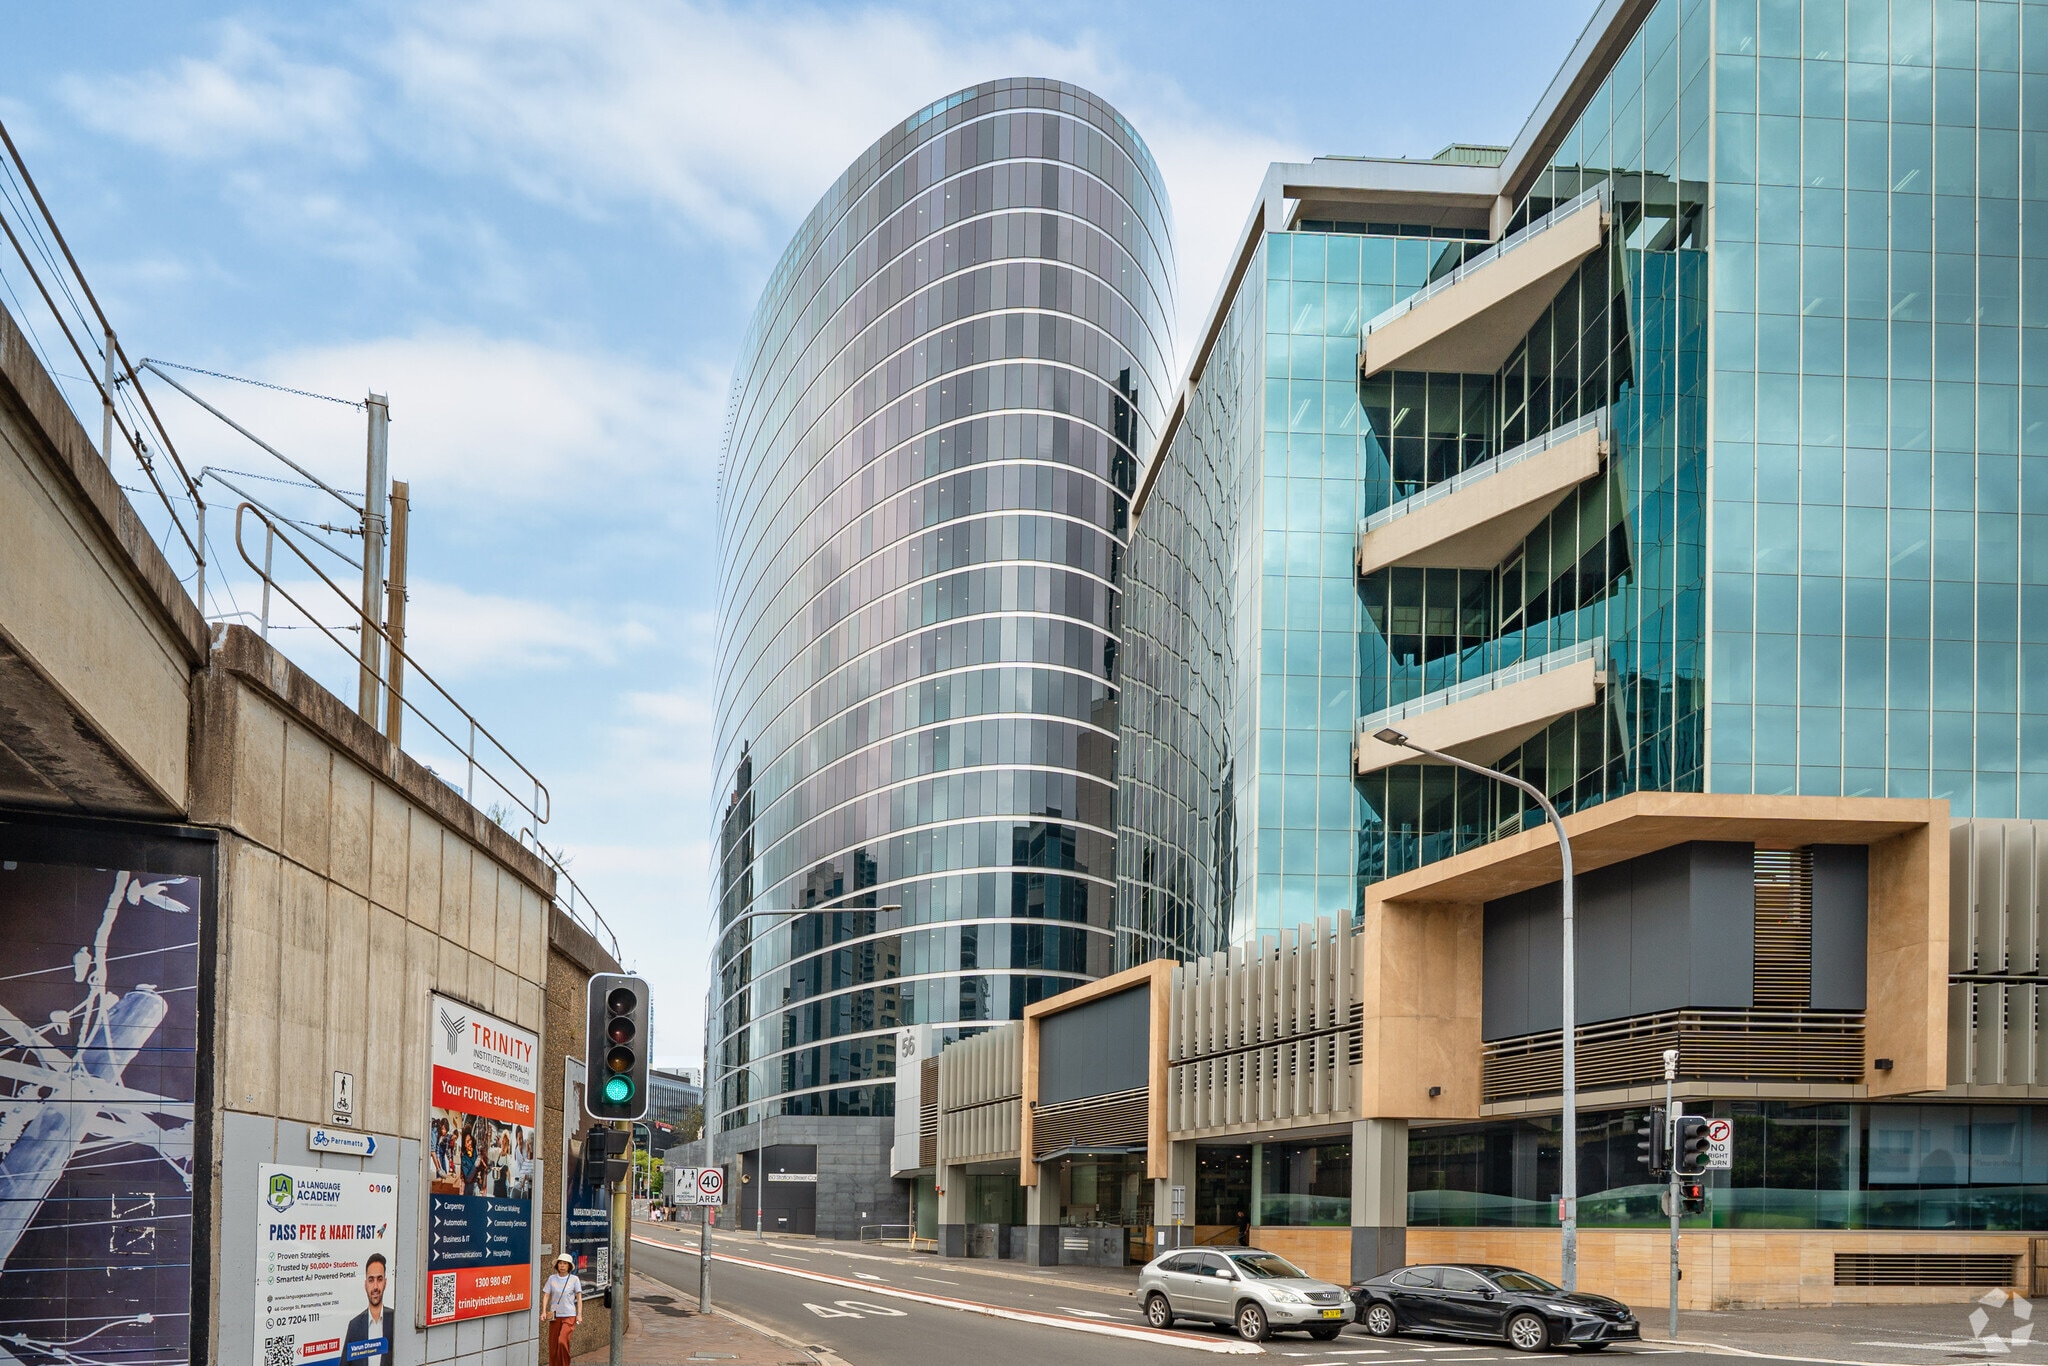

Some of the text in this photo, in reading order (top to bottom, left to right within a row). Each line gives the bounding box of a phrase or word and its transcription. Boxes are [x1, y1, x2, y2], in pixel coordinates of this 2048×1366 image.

[472, 1022, 532, 1063] TRINITY
[902, 1035, 915, 1058] 56
[441, 1080, 530, 1114] Your FUTURE starts here
[331, 1137, 363, 1147] Parramatta
[1711, 1144, 1725, 1152] NO
[275, 1179, 288, 1192] LA
[297, 1180, 341, 1191] LA LANGUAGE
[702, 1176, 720, 1188] 40
[297, 1190, 341, 1202] ACADEMY
[699, 1195, 722, 1203] AREA
[444, 1202, 465, 1212] Carpentry
[443, 1219, 468, 1227] Automotive
[494, 1220, 514, 1228] Community
[269, 1224, 376, 1241] PASS PTE & NAATI FAST
[493, 1235, 508, 1243] Cookery
[1103, 1238, 1117, 1254] 56
[277, 1251, 331, 1260] Proven Strategies.
[442, 1251, 482, 1259] Telecommunications
[277, 1261, 358, 1272] Trusted by 50,000+ Students.
[276, 1275, 304, 1284] Smartest
[314, 1272, 339, 1280] Powered
[339, 1271, 356, 1279] Portal.
[475, 1275, 512, 1288] 1300 980 497
[458, 1292, 524, 1310] trinityinstitute.edu.au
[802, 1300, 908, 1319] 40
[276, 1313, 320, 1327] 02 7204 1111
[305, 1341, 338, 1353] FREE MOCK TEST
[351, 1341, 381, 1352] Varun Dhawan
